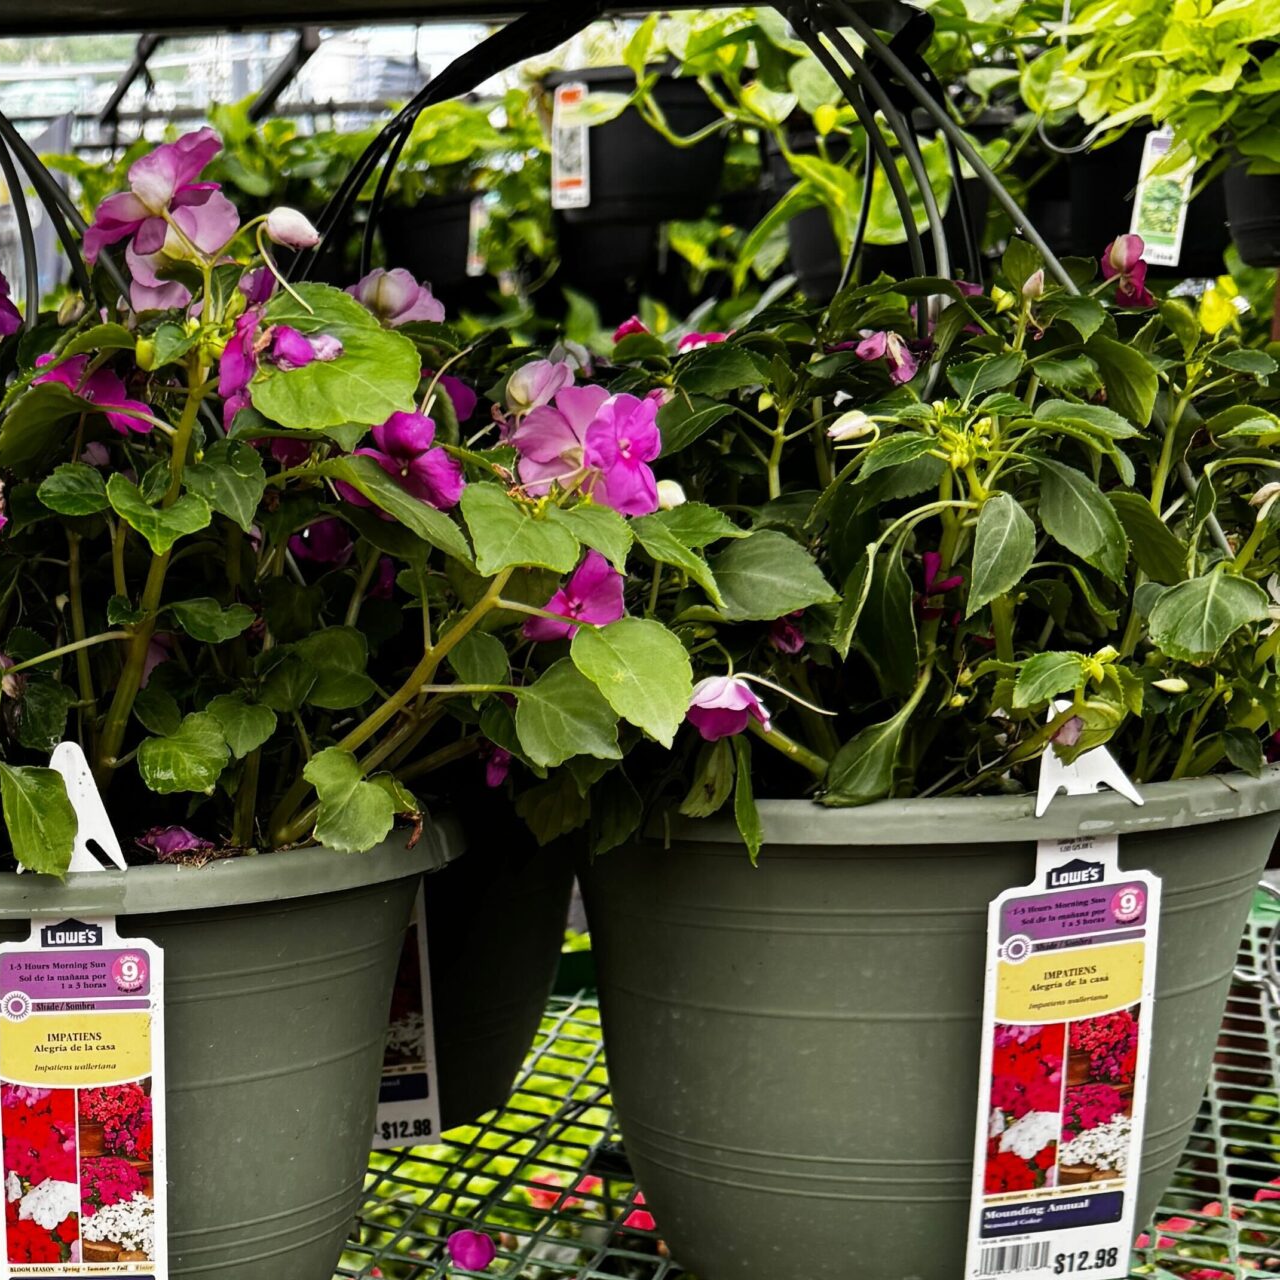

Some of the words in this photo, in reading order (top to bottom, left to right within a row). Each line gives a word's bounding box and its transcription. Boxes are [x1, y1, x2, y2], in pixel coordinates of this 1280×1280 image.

[1052, 868, 1100, 886] LOWE'S
[1028, 905, 1052, 913] Hours
[1055, 900, 1088, 909] Morning
[1120, 893, 1137, 914] 9
[1092, 909, 1106, 917] por
[48, 929, 96, 944] LOWE'S
[122, 960, 138, 980] 9
[1044, 965, 1097, 981] IMPATIENS
[36, 1003, 60, 1011] Shade
[66, 1002, 95, 1010] Sombra
[1028, 1000, 1066, 1010] Impatiens
[48, 1032, 102, 1042] IMPATIENS
[34, 1064, 72, 1072] Impatiens
[382, 1119, 431, 1139] $12.98
[984, 1206, 1045, 1220] Mounding
[1047, 1200, 1090, 1212] Annual
[1054, 1248, 1119, 1275] $12.98
